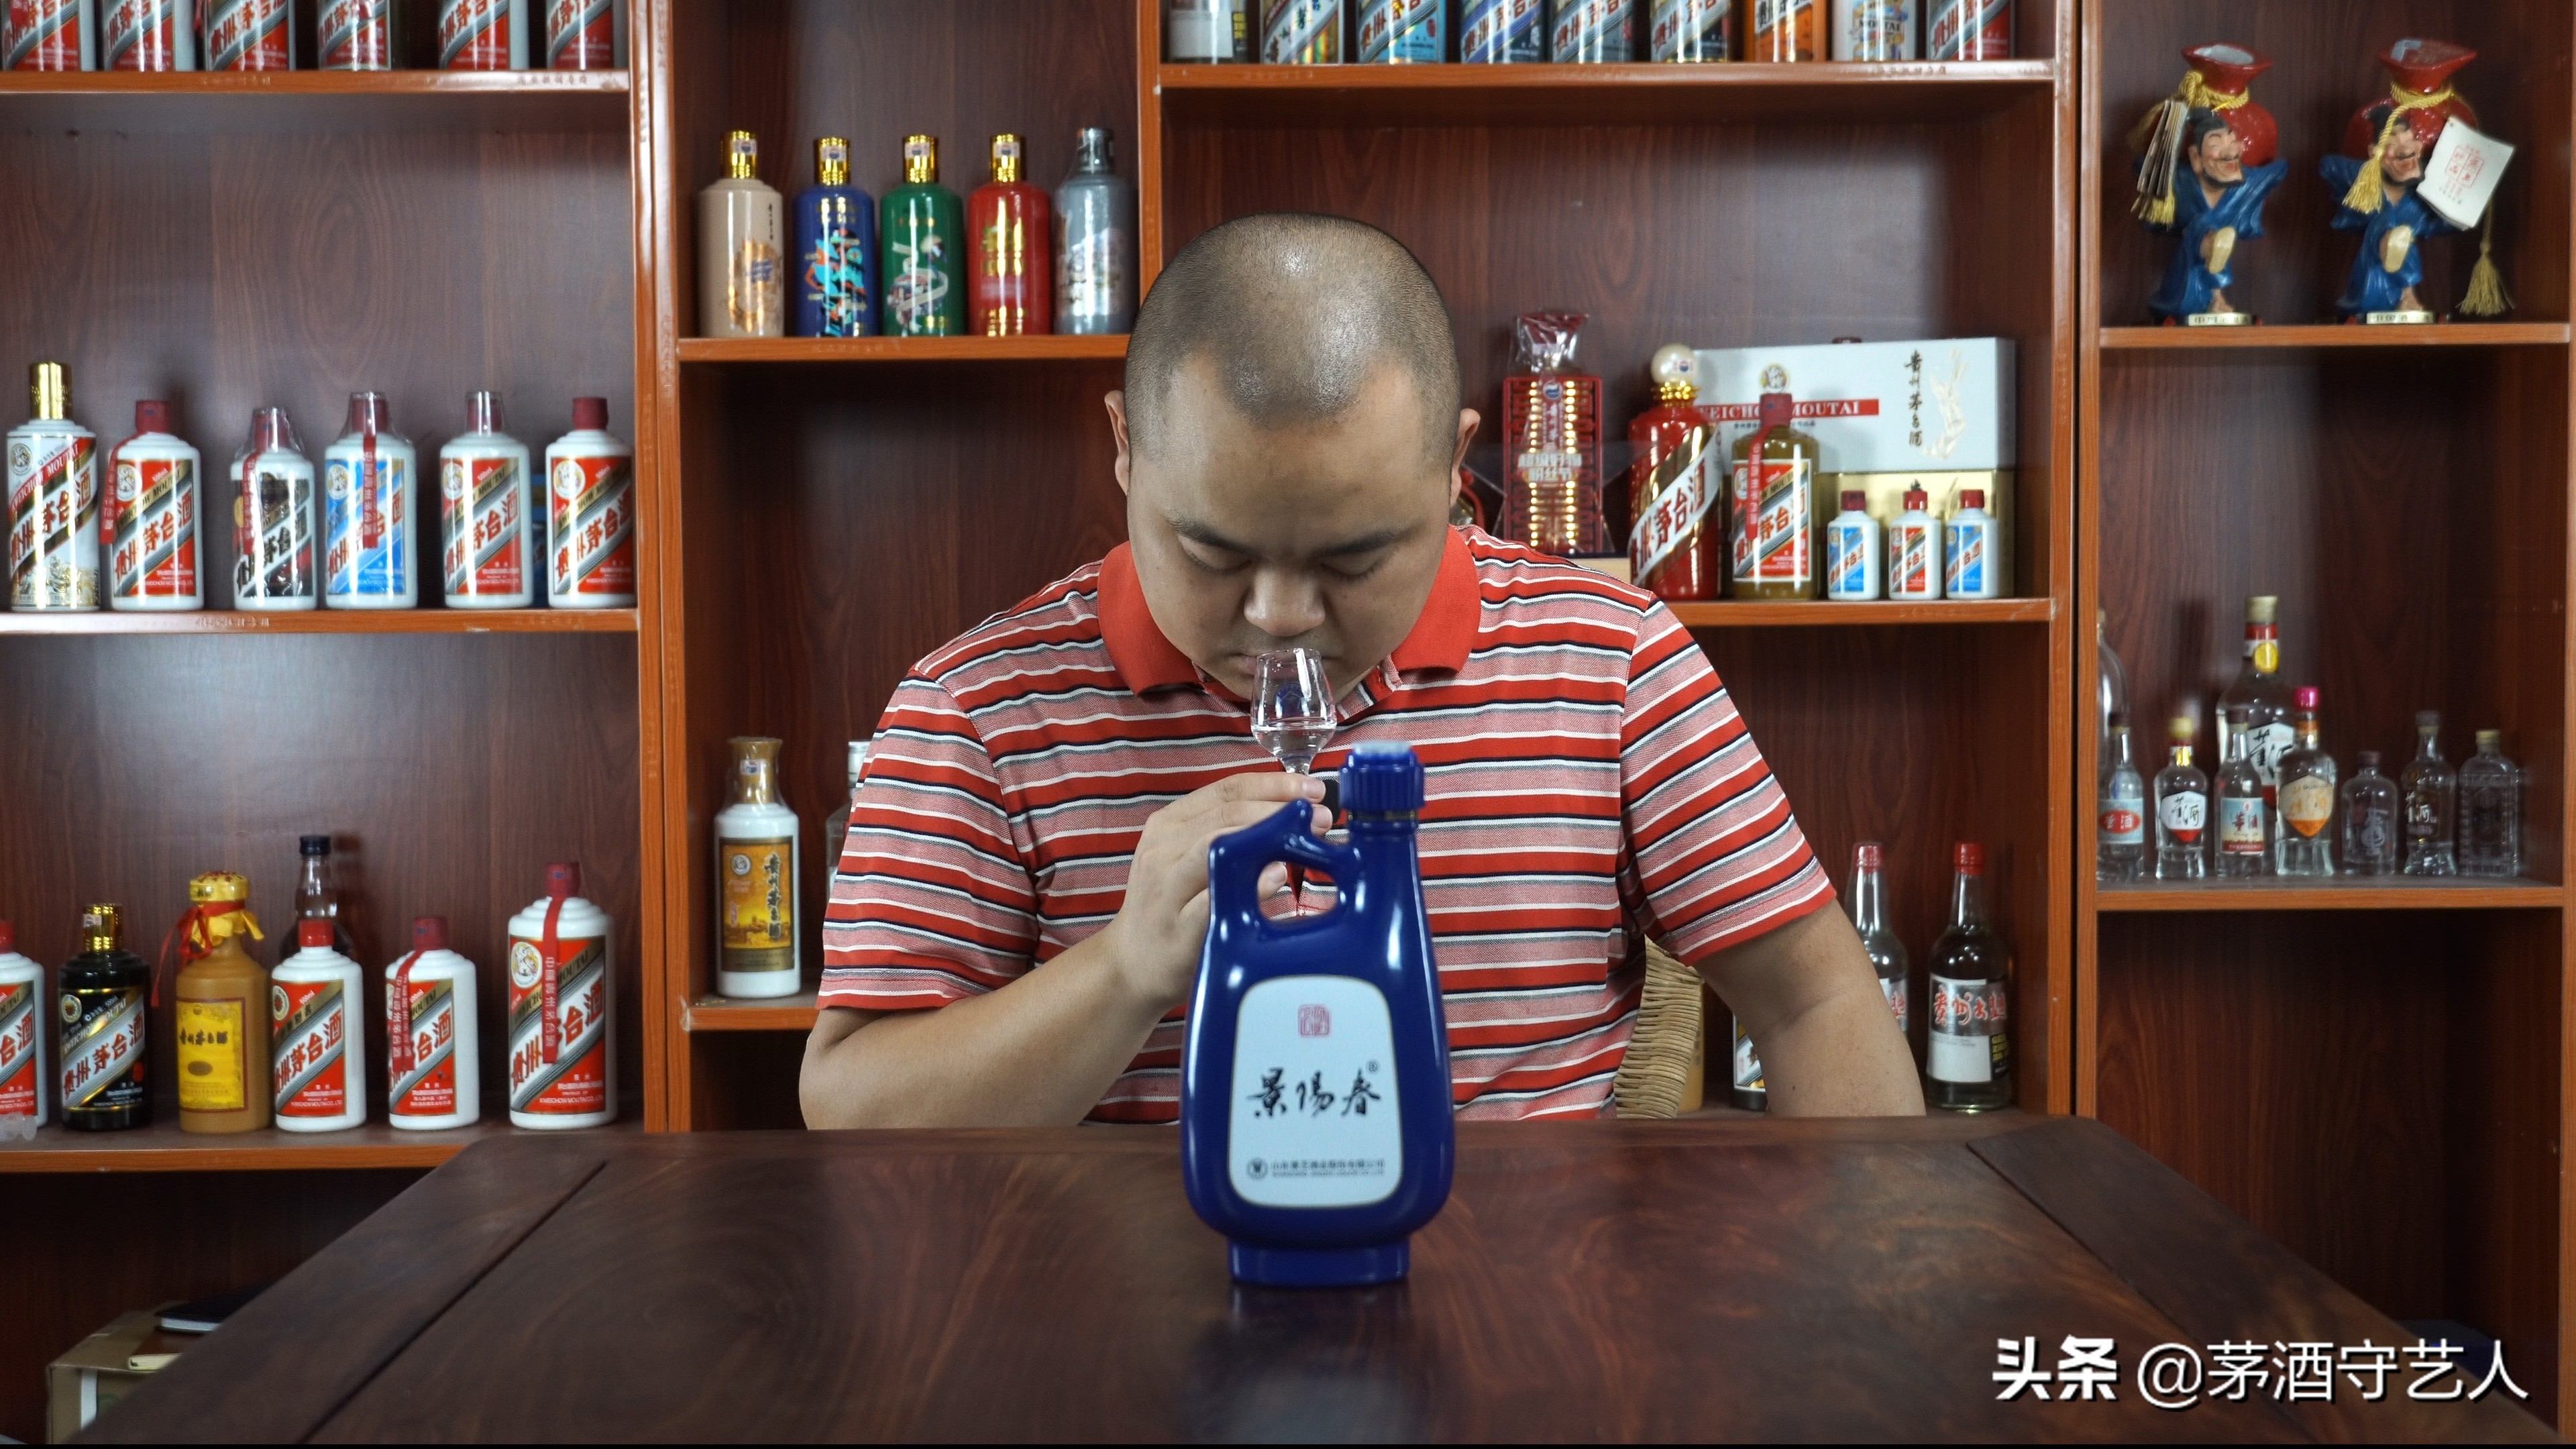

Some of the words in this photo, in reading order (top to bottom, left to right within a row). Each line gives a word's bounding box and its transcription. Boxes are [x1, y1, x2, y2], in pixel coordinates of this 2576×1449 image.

[64, 1011, 144, 1101] 贵州茅台酒
